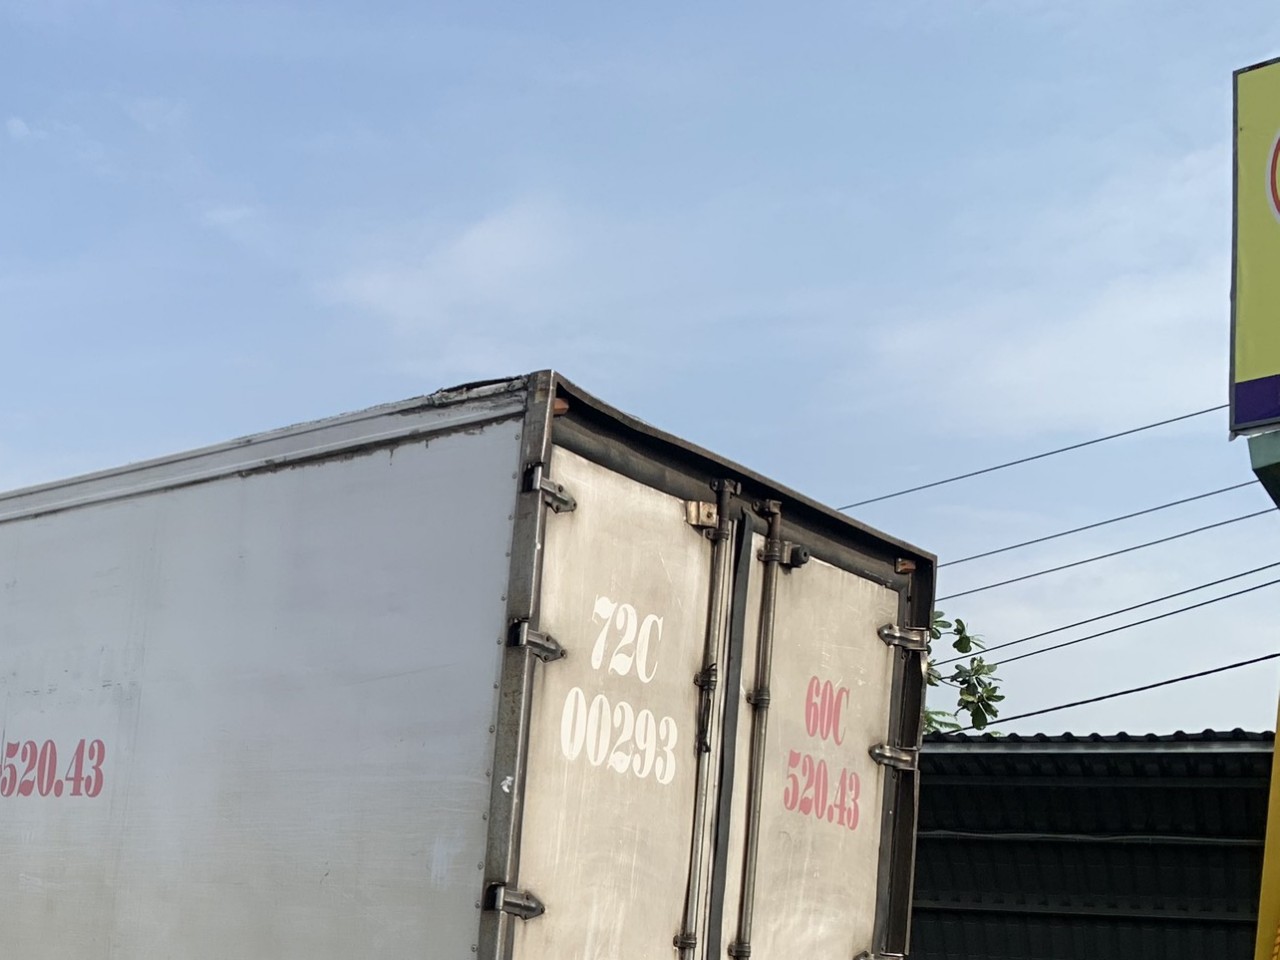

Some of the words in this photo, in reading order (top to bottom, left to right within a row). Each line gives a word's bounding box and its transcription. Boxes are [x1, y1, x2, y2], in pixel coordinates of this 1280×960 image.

[591, 595, 664, 683] 72C
[561, 687, 678, 785] 00293
[805, 675, 850, 746] 60C
[783, 749, 860, 831] 520.43
